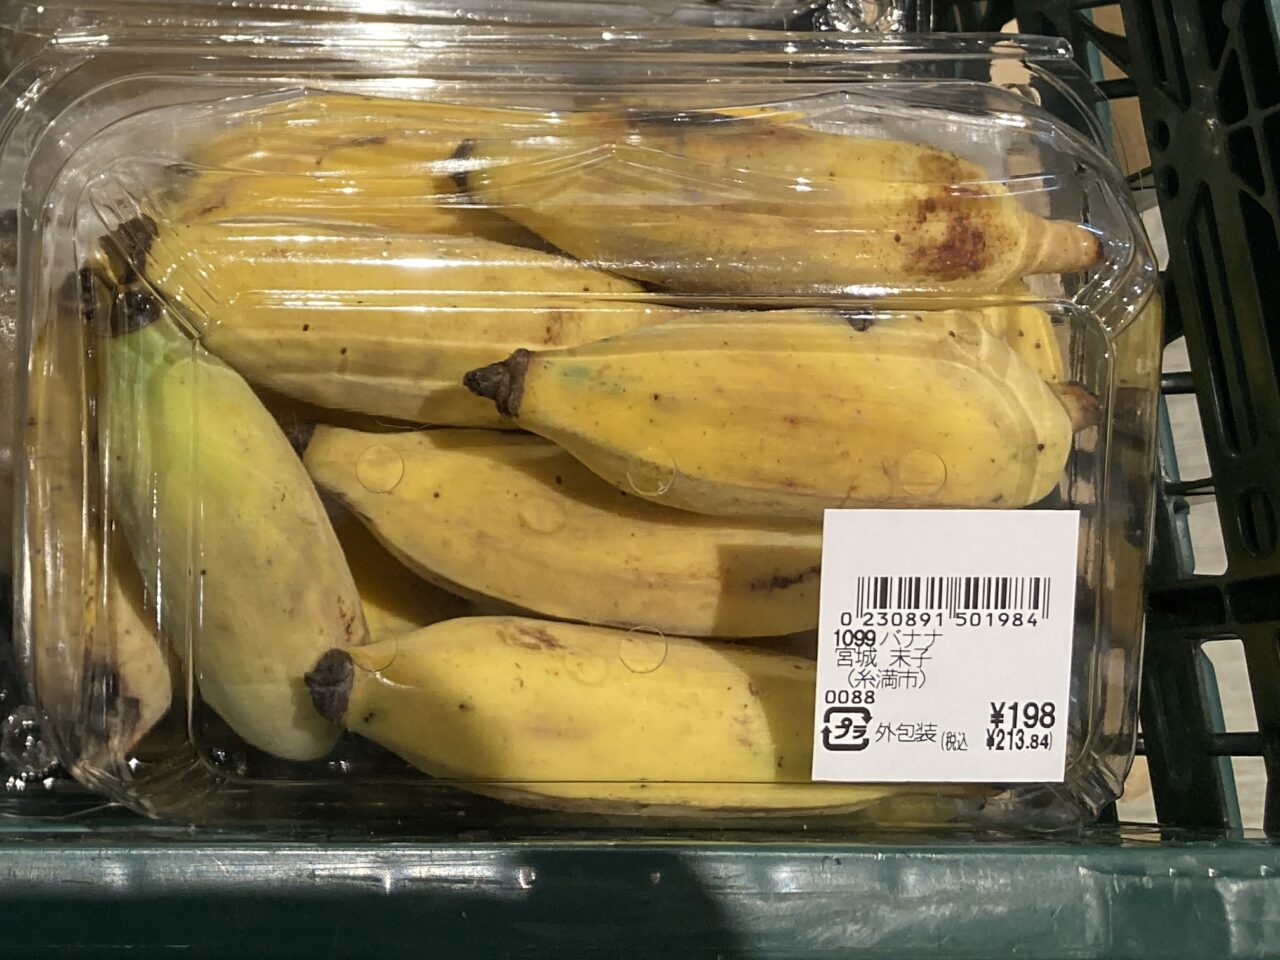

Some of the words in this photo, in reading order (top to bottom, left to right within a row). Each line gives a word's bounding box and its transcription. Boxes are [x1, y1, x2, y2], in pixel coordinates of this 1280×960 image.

[841, 613, 852, 626] 0
[863, 613, 943, 626] 230891
[955, 613, 1038, 627] 501984
[834, 630, 876, 646] 1099
[880, 630, 943, 647] バナナ
[835, 648, 877, 667] 宮城
[825, 690, 875, 704] 0088
[990, 702, 1055, 729] ¥198
[875, 723, 937, 743] 外包装
